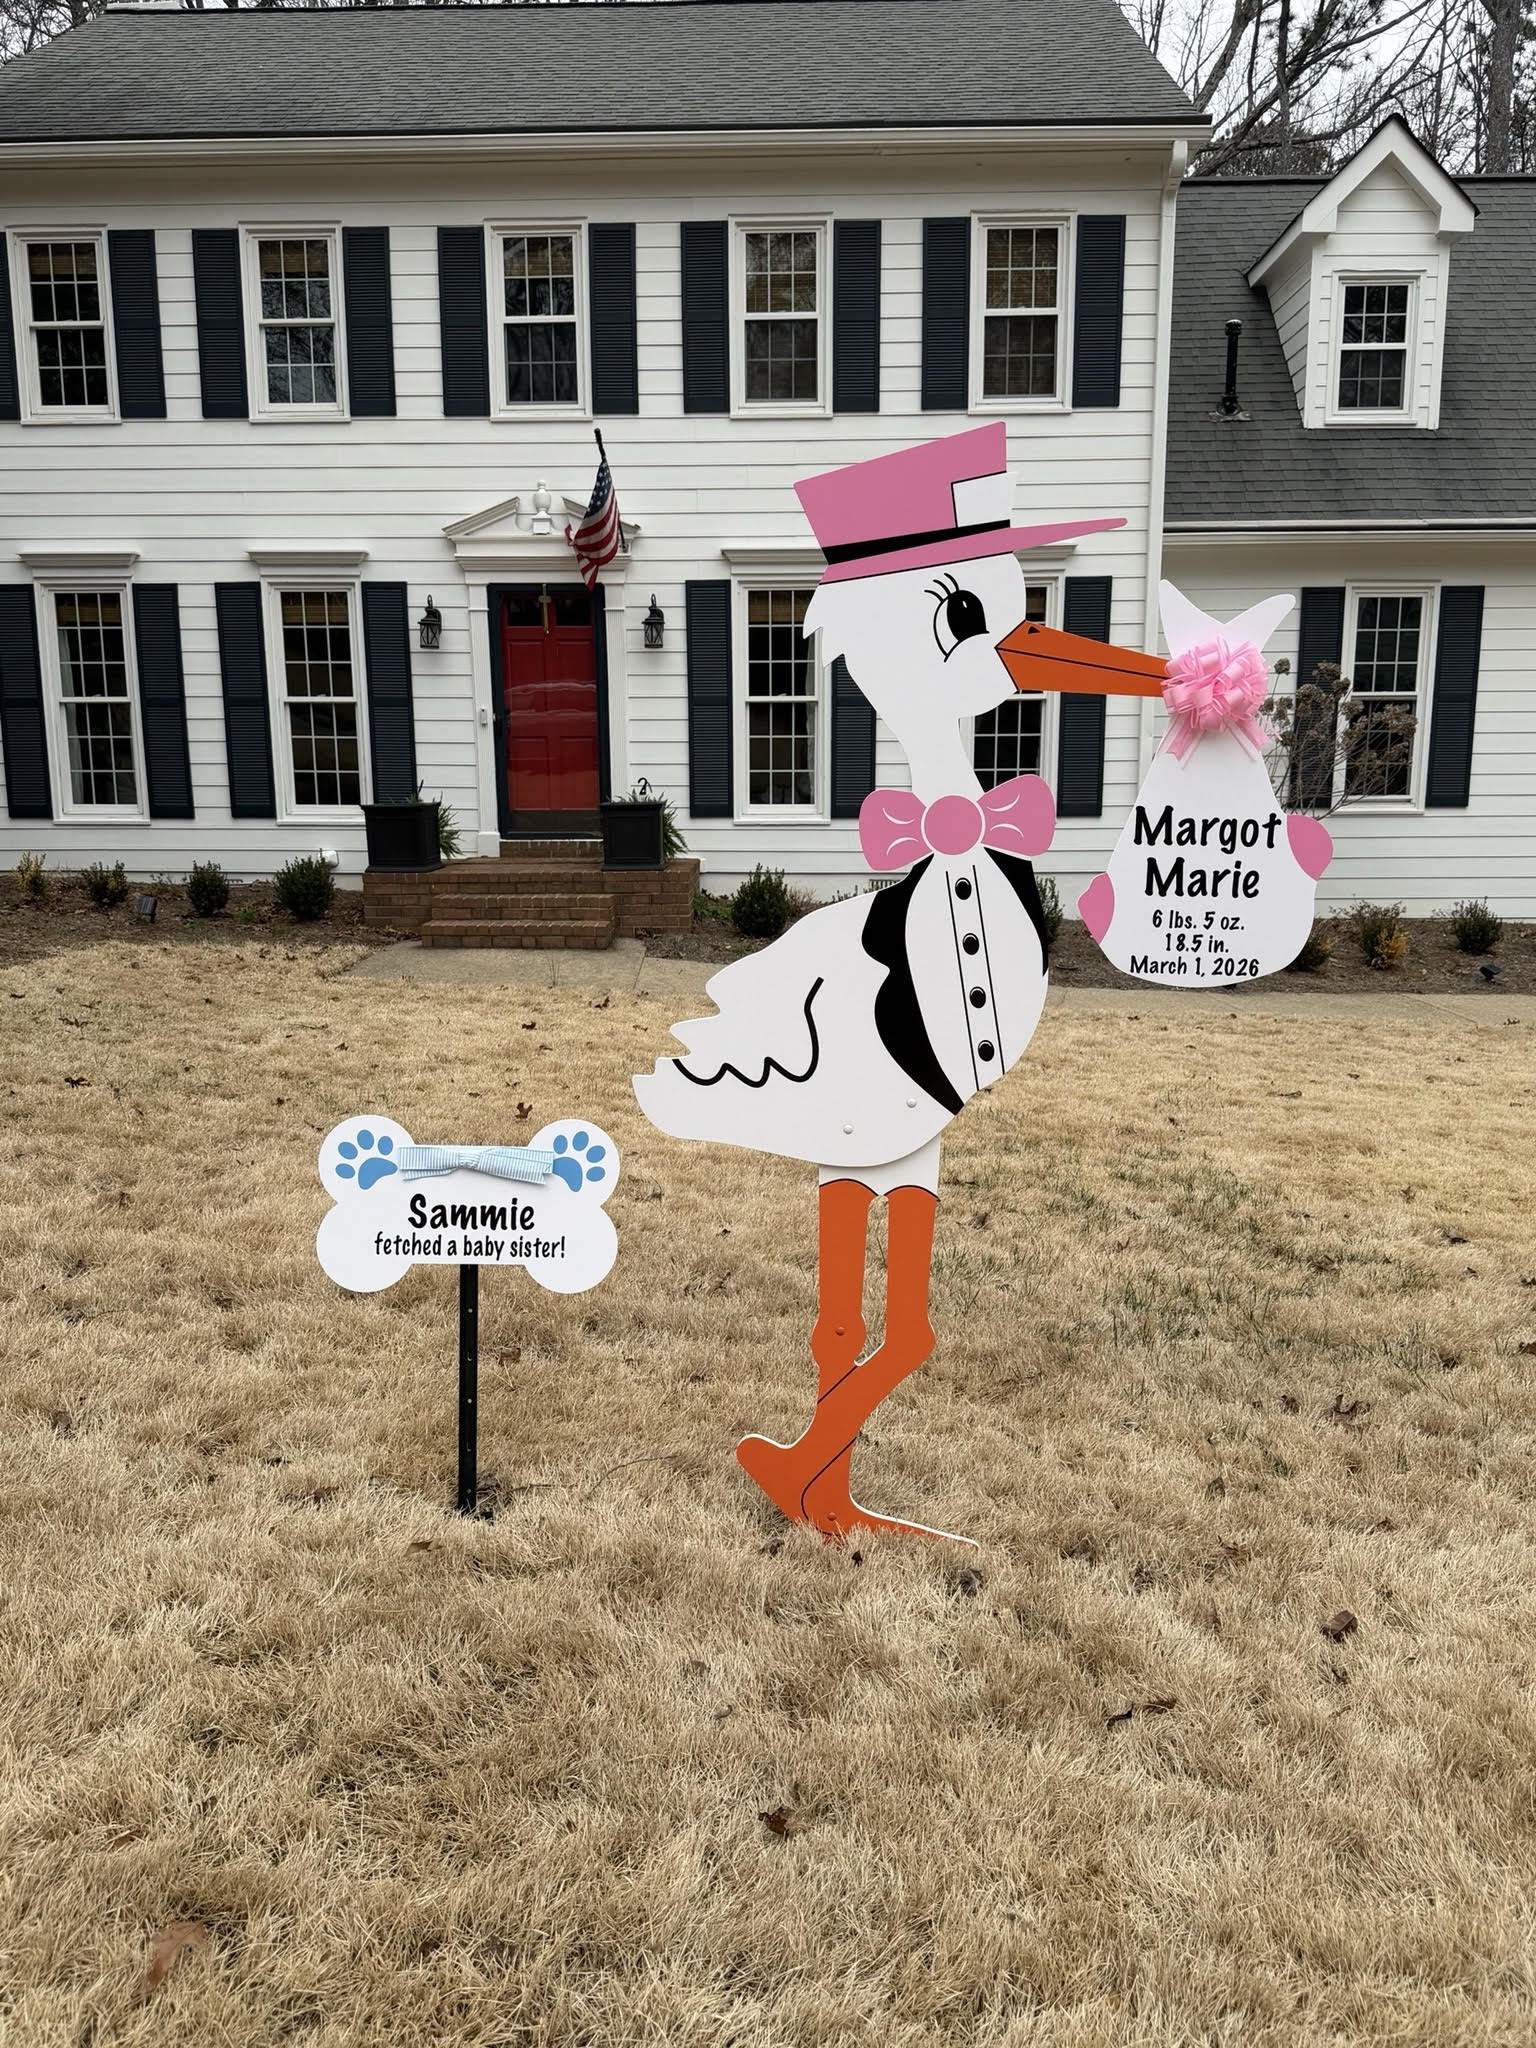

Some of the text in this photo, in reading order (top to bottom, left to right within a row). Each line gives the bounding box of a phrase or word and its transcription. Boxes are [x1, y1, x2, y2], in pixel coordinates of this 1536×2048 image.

[1133, 805, 1282, 854] Margot
[1145, 857, 1259, 898] Marie
[1153, 909, 1244, 930] 6 lbs. 5 oz.
[1166, 933, 1228, 953] 18.5 in.
[1130, 956, 1260, 977] March 1, 2026
[408, 1194, 534, 1230] Sammie
[375, 1231, 565, 1261] fetched a baby sister!
